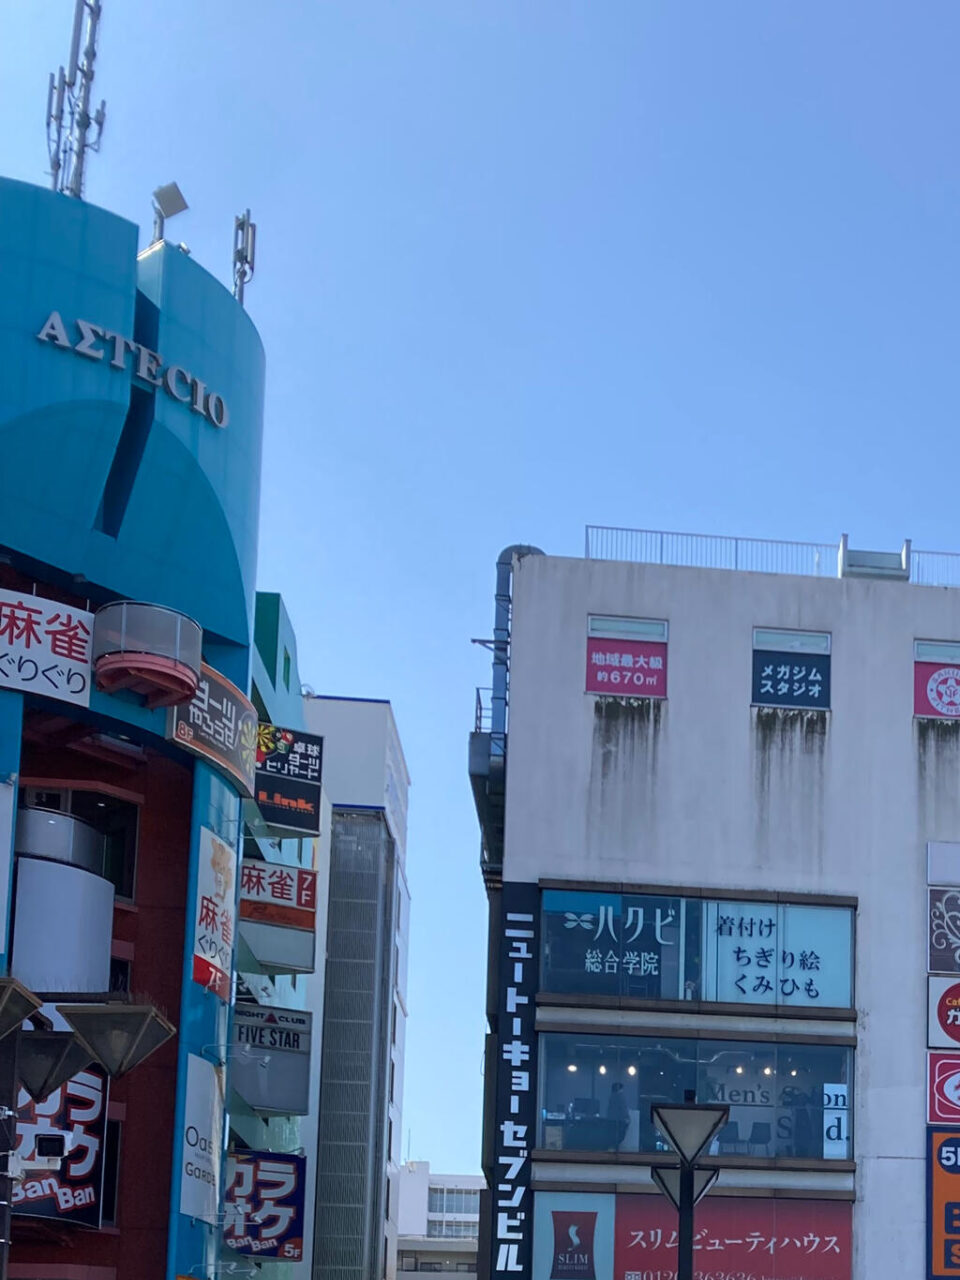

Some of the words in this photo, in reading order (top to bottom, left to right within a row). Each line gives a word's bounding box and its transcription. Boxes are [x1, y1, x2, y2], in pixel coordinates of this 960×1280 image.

[0, 601, 90, 664] 麻雀
[591, 652, 663, 670] 地域最大級
[761, 665, 822, 682] メガジム
[760, 680, 822, 697] スタジオ
[178, 721, 193, 740] 8F
[241, 864, 294, 901] 麻雀
[301, 874, 313, 905] 7F
[199, 895, 232, 948] 麻雀
[593, 905, 676, 946] ハクビ
[718, 915, 776, 938] 着付け
[584, 949, 659, 976] 総合学院
[733, 946, 820, 971] ちぎり絵
[733, 975, 820, 999] くみひも
[278, 1015, 306, 1026] CLUB
[238, 1025, 265, 1044] FIVE
[269, 1028, 300, 1049] STAR
[495, 911, 534, 1272] ニュートーキョーセブンビル
[223, 1157, 296, 1199] カラ
[223, 1196, 295, 1239] オケ
[283, 1244, 301, 1257] 5F
[558, 1253, 589, 1265] SLIM
